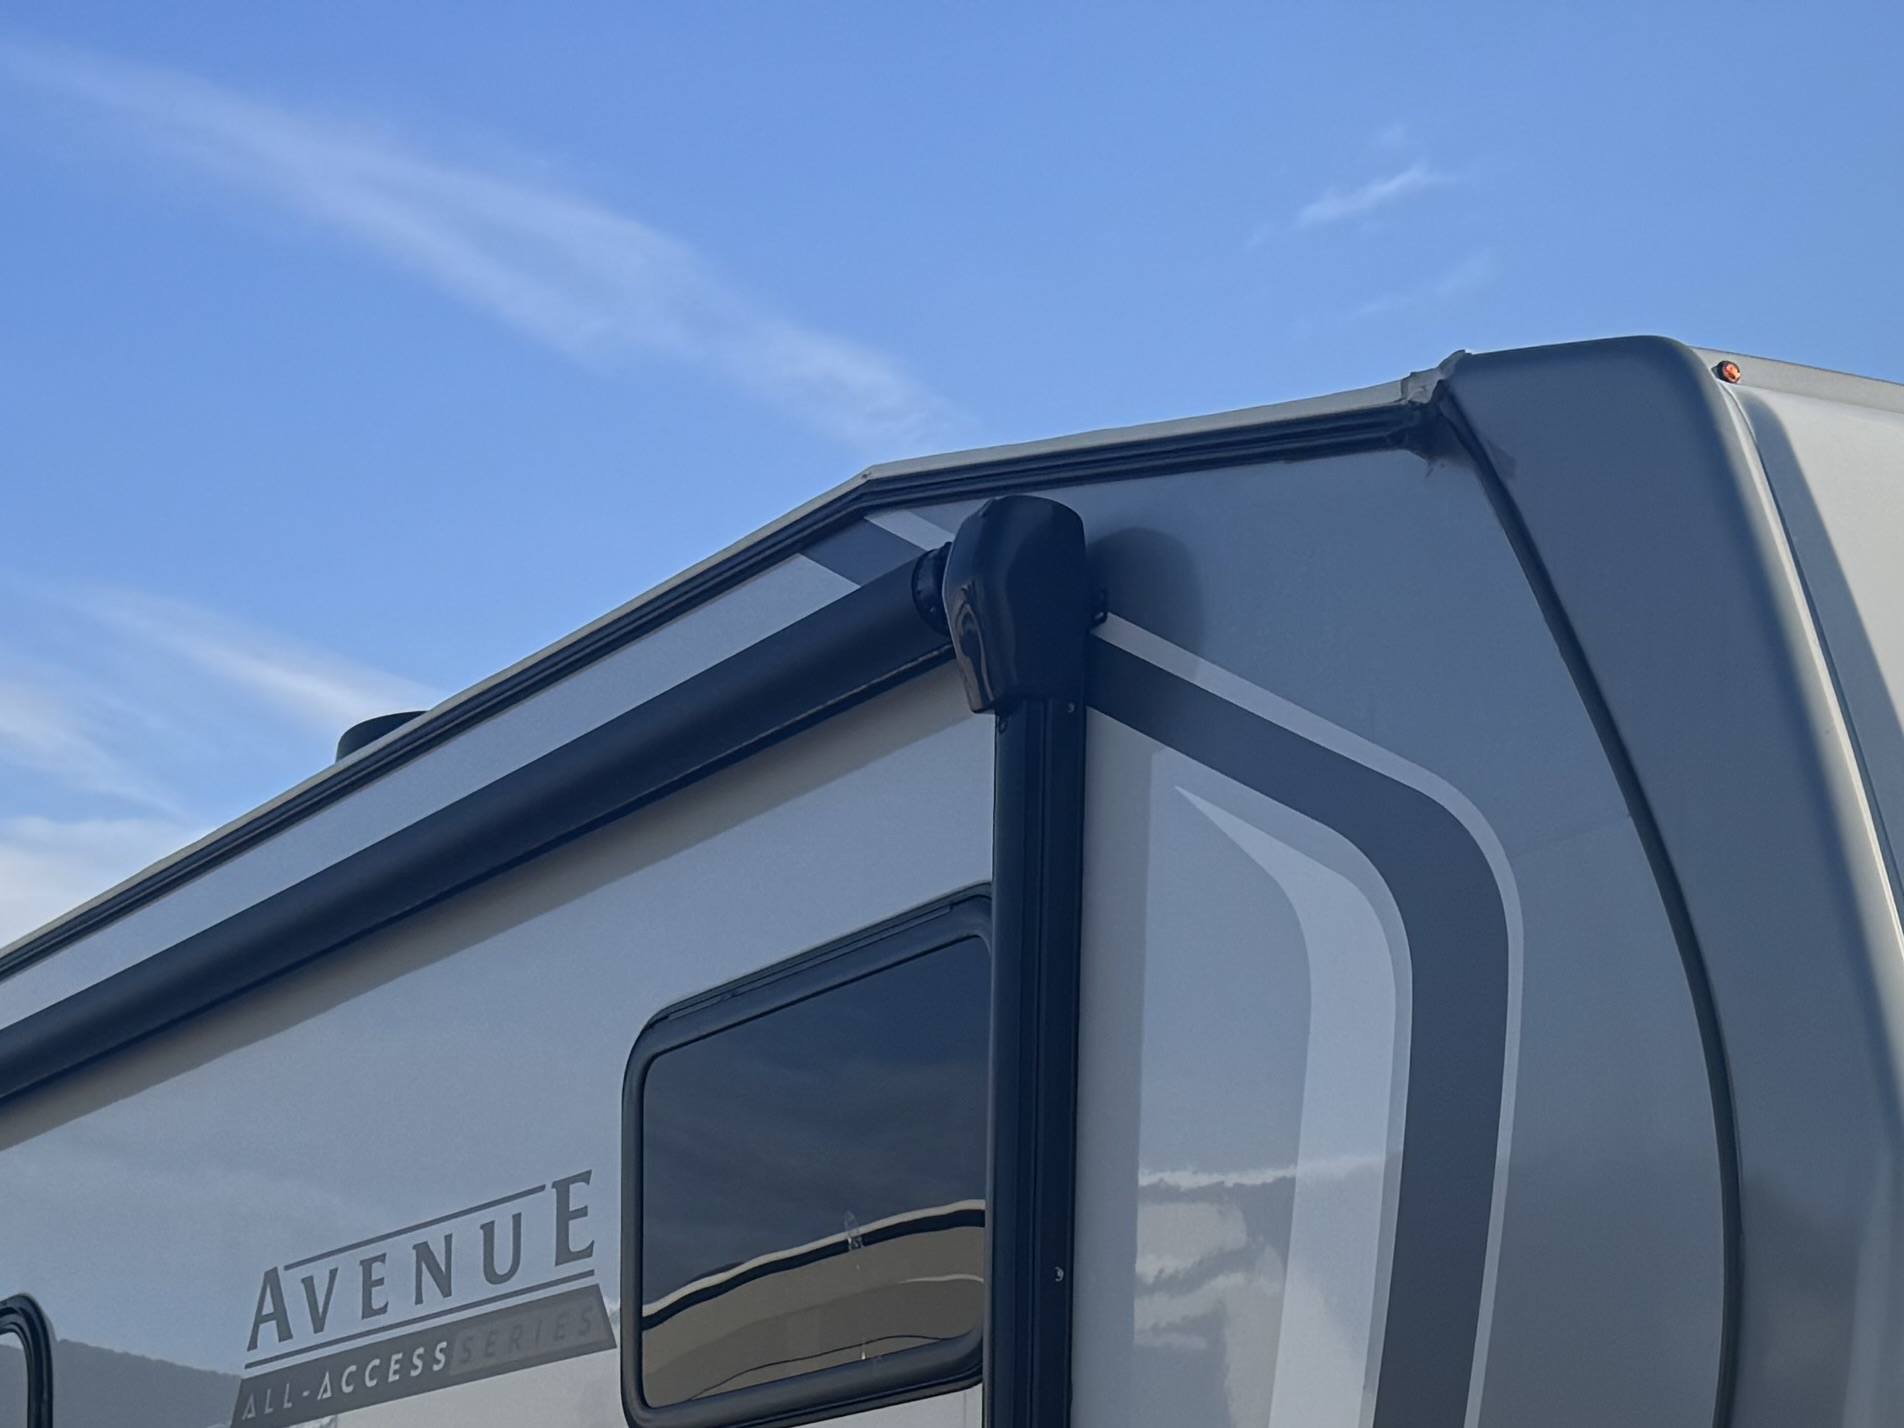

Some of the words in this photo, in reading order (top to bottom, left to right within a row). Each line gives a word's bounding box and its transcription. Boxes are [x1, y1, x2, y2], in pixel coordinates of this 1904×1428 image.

[247, 1169, 595, 1351] AVENUE
[241, 1342, 448, 1421] ALL-ACCESS
[459, 1305, 594, 1365] SERIES
